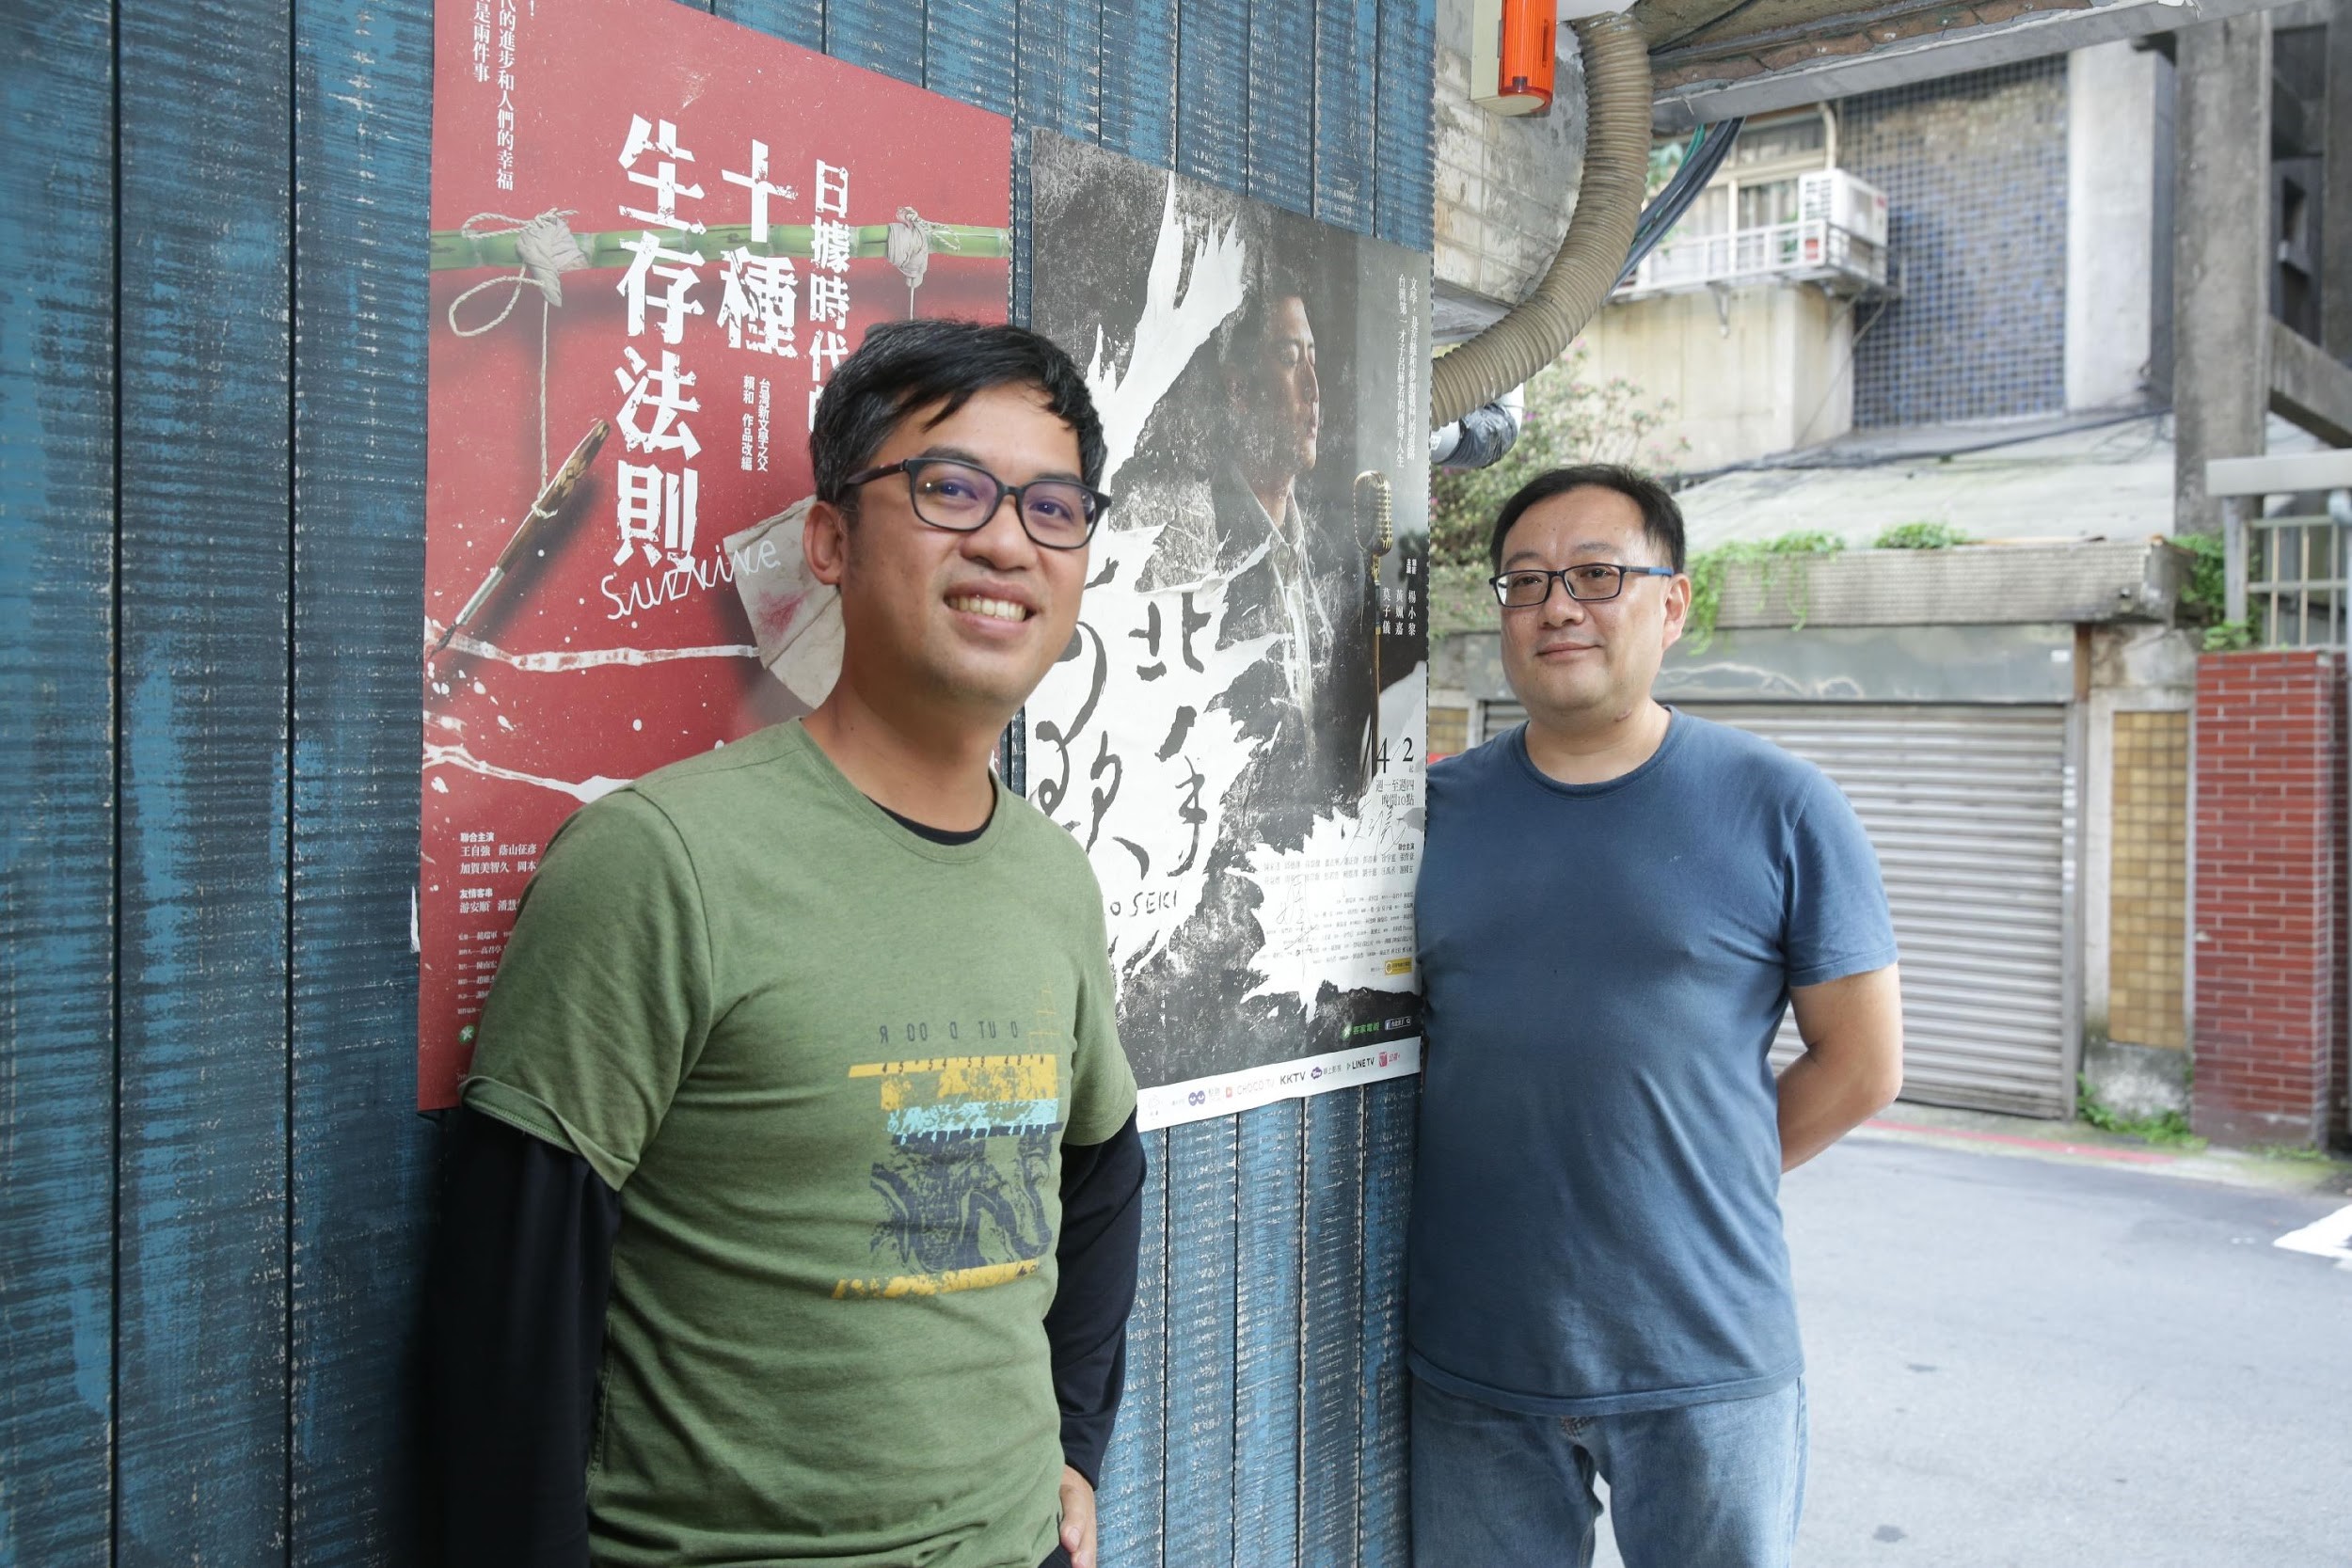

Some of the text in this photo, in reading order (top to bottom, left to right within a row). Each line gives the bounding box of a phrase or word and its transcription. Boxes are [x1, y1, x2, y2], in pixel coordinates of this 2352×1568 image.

[472, 0, 490, 83] 是兩件事
[717, 139, 800, 360] 十種
[808, 159, 850, 433] 日據時代
[613, 114, 706, 567] 生存法則
[740, 413, 754, 471] 作品改編
[757, 378, 771, 472] 台灣新文學之父
[1109, 891, 1178, 917] OSEKI
[1279, 1071, 1307, 1085] KKTV
[1352, 1056, 1375, 1069] LINE TV
